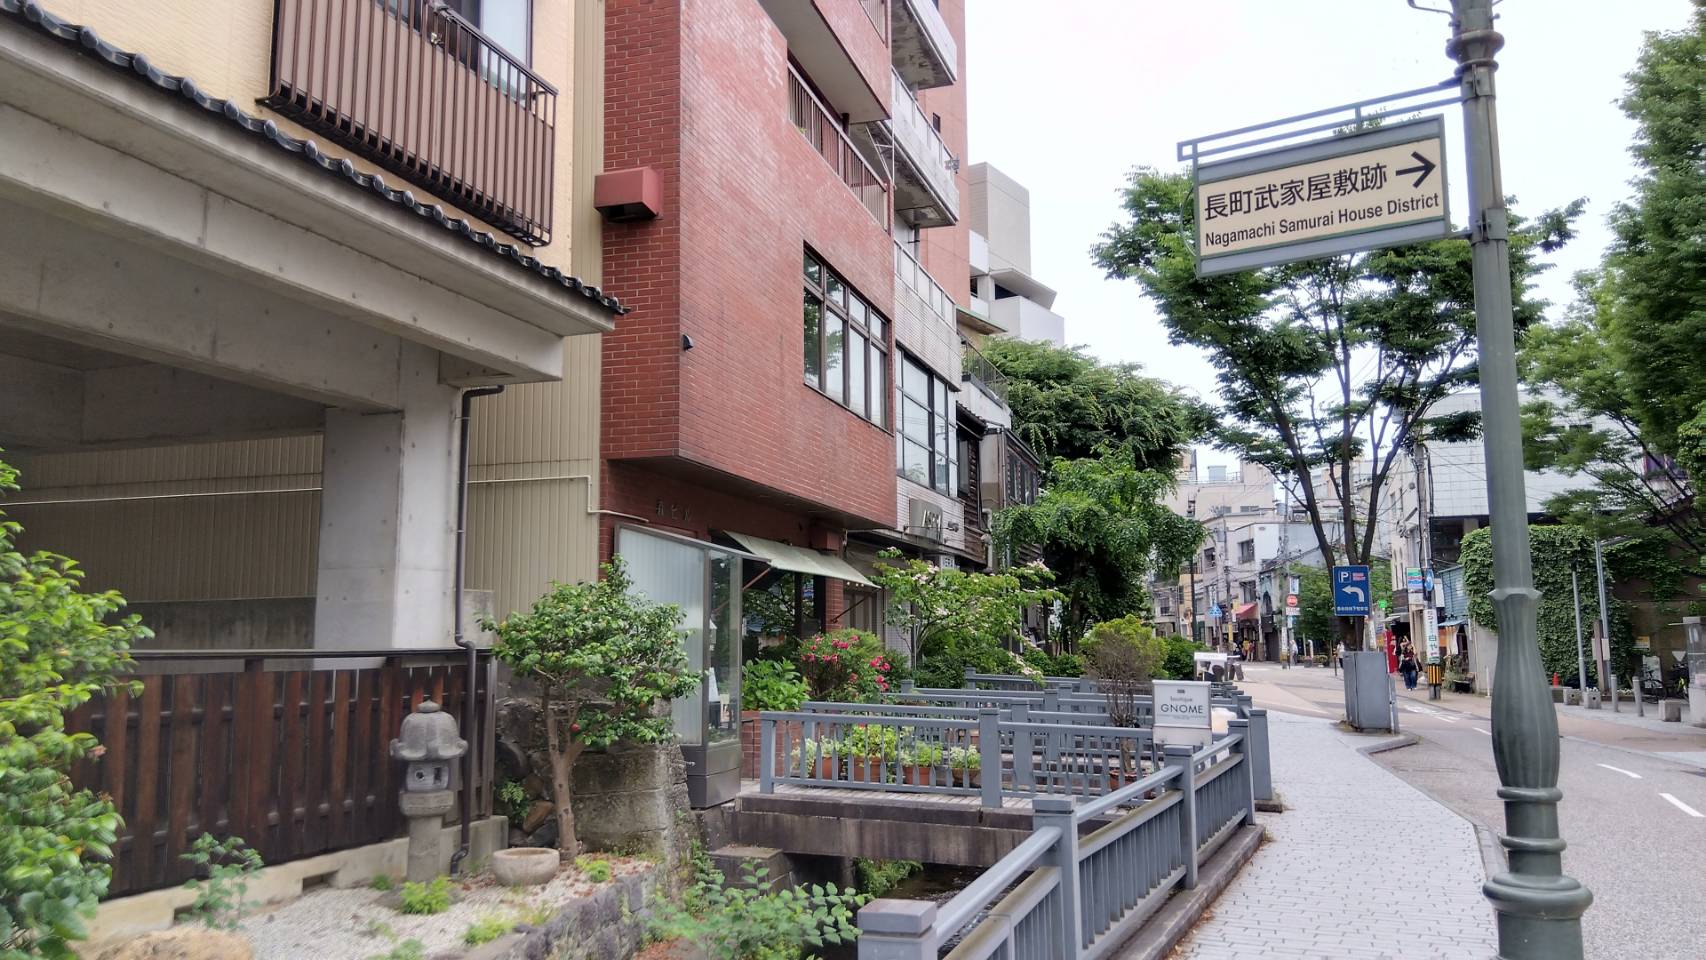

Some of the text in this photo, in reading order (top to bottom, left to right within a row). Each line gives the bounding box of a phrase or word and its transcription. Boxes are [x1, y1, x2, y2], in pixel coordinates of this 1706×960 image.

[1204, 162, 1387, 221] 長町武家屋敷跡
[1205, 193, 1440, 247] Nagamachi Samurai House District
[1341, 571, 1349, 583] P
[1160, 703, 1204, 714] GNOME
